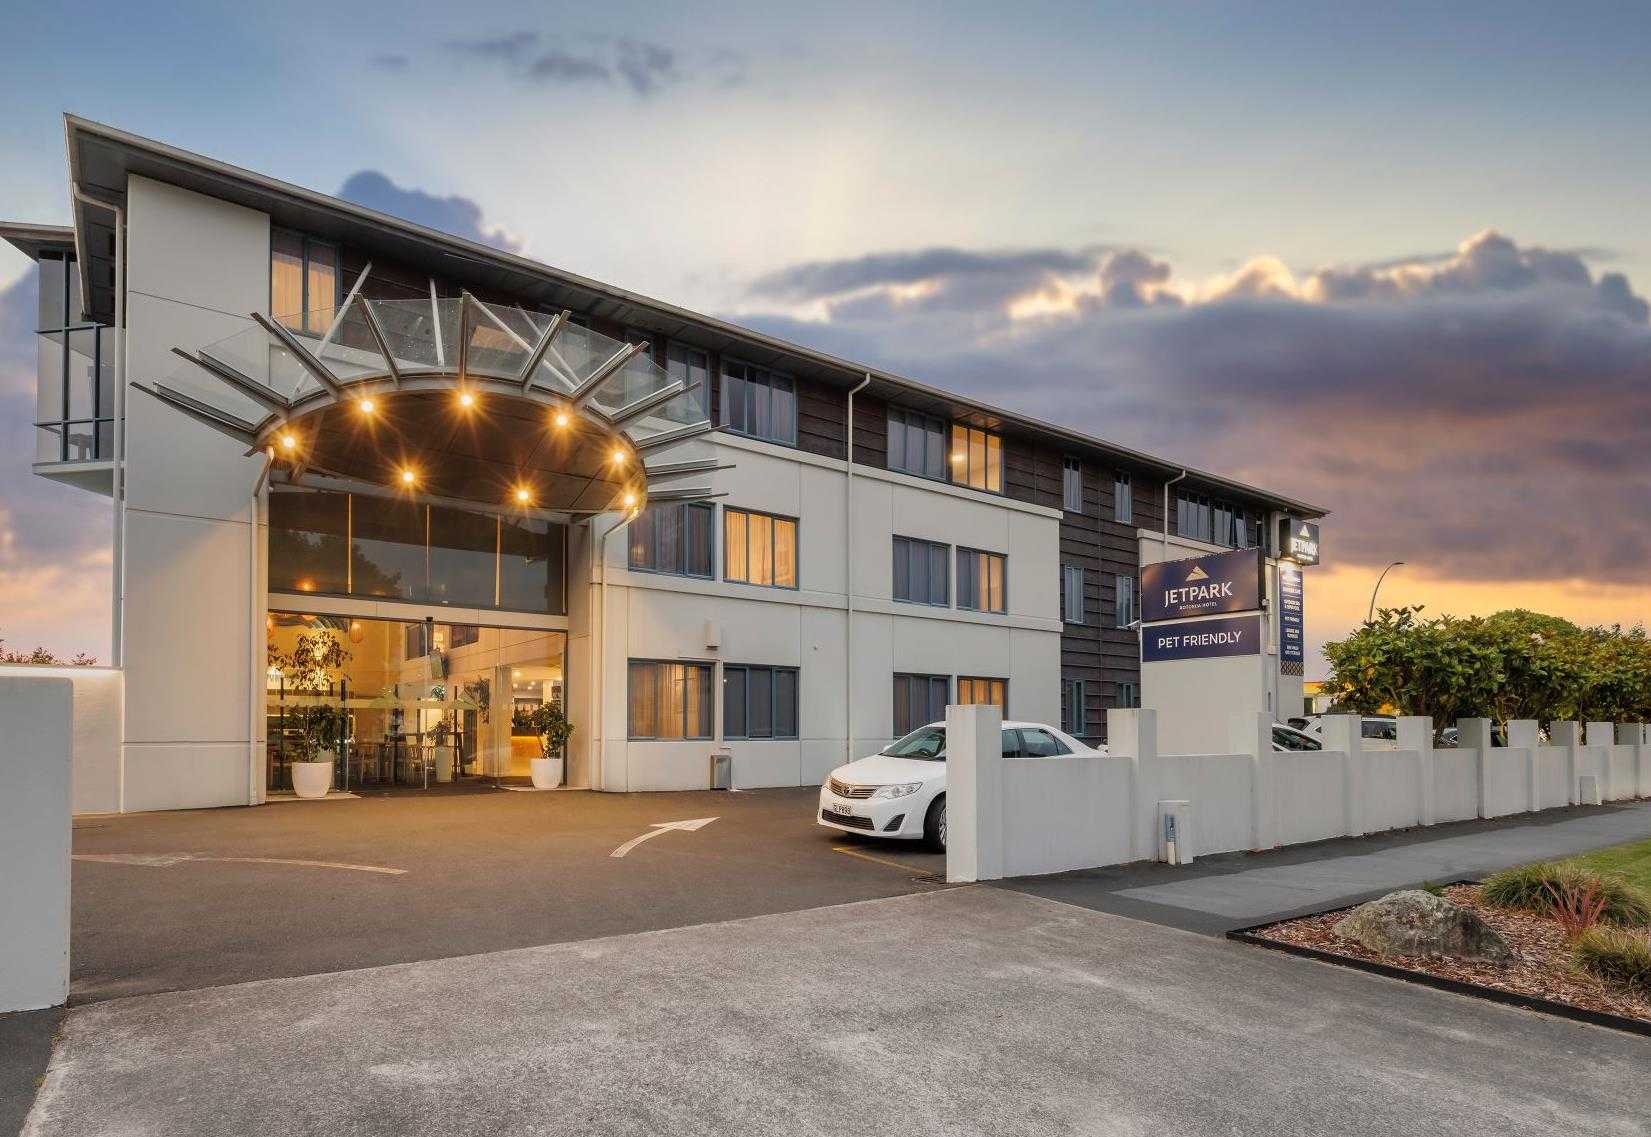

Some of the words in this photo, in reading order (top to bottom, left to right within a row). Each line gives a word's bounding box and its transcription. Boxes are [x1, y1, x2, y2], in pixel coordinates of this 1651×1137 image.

[1164, 581, 1233, 608] JETPARK
[1158, 636, 1180, 649] PET
[1183, 630, 1242, 647] FRIENDLY
